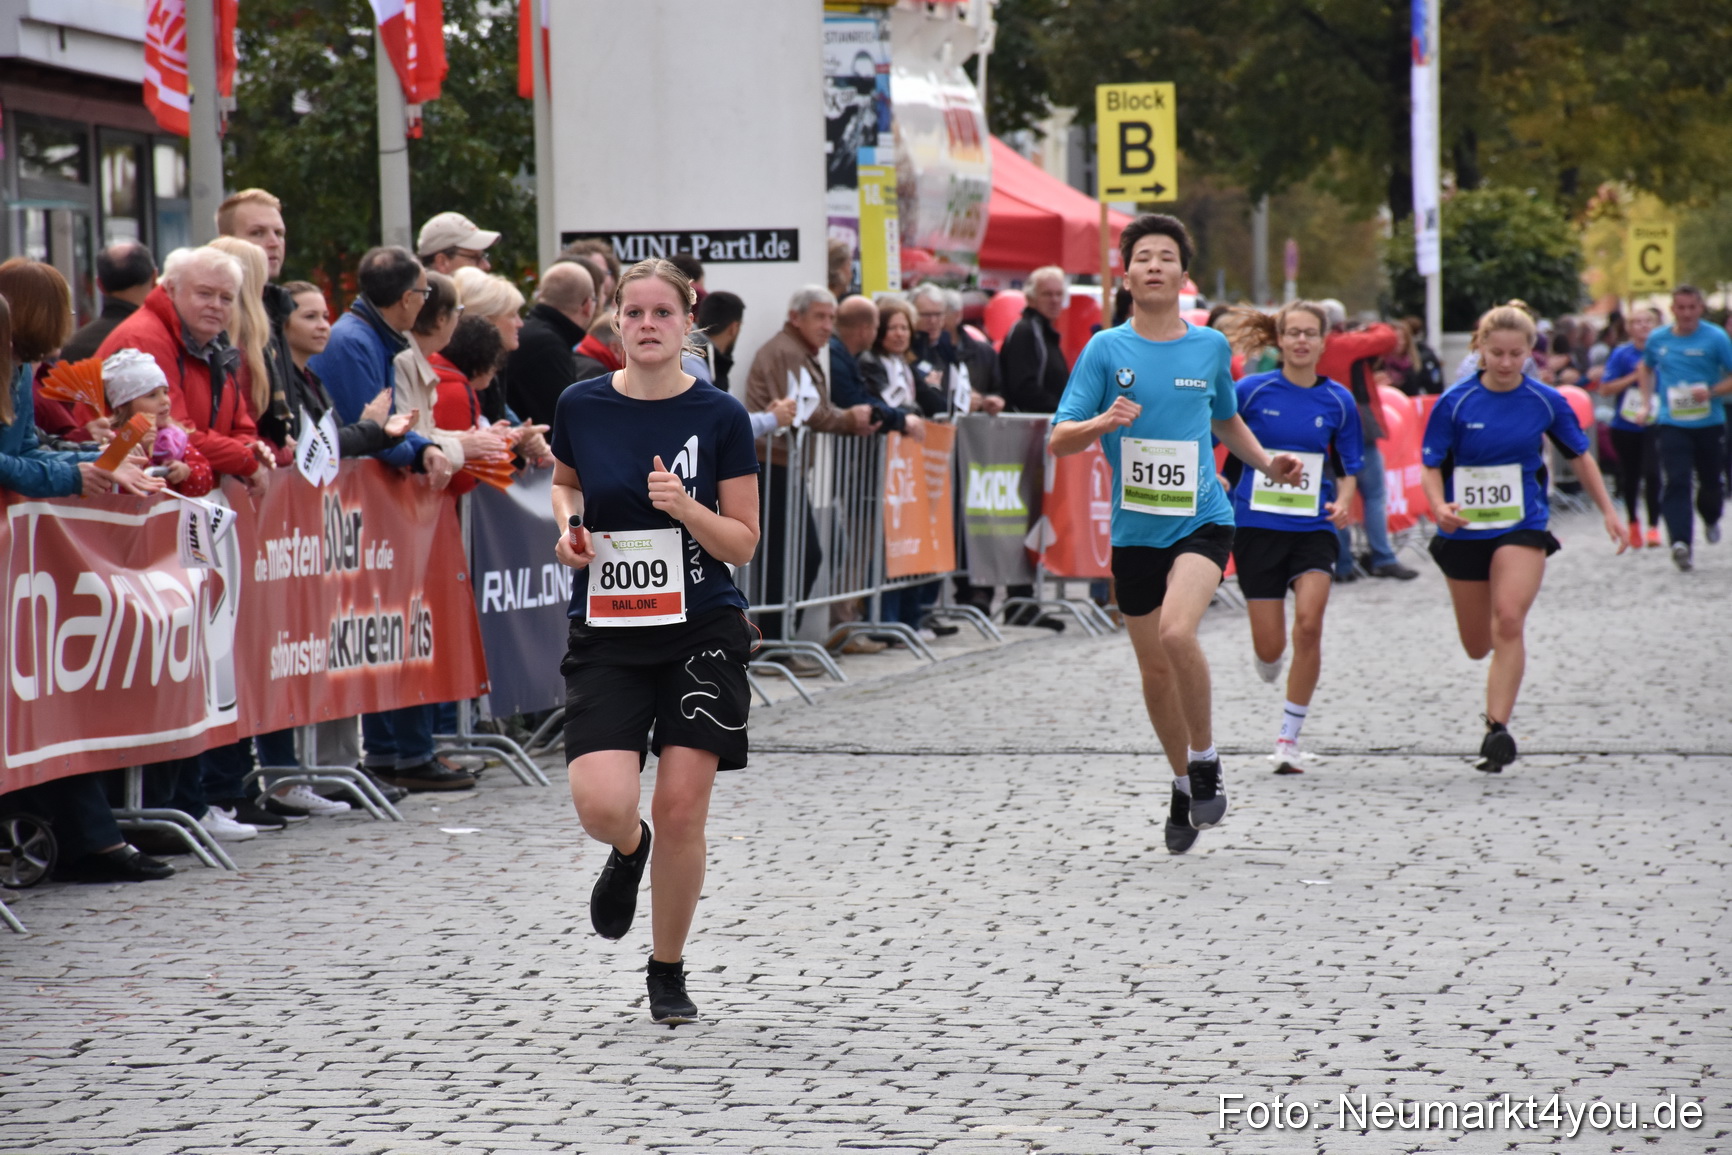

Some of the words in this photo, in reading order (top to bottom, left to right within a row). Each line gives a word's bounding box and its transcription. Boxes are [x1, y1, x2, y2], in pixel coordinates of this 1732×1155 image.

[1107, 90, 1165, 111] Block
[1119, 121, 1156, 175] B
[1640, 243, 1662, 276] C
[1174, 378, 1208, 389] BOCK
[1132, 461, 1185, 486] 5195
[1125, 488, 1159, 502] Mohamad
[1161, 493, 1193, 504] Ghasem
[1465, 484, 1512, 505] 5130
[619, 540, 653, 549] BOCK
[600, 559, 668, 590] 8009
[612, 598, 658, 611] RAIL.ONE
